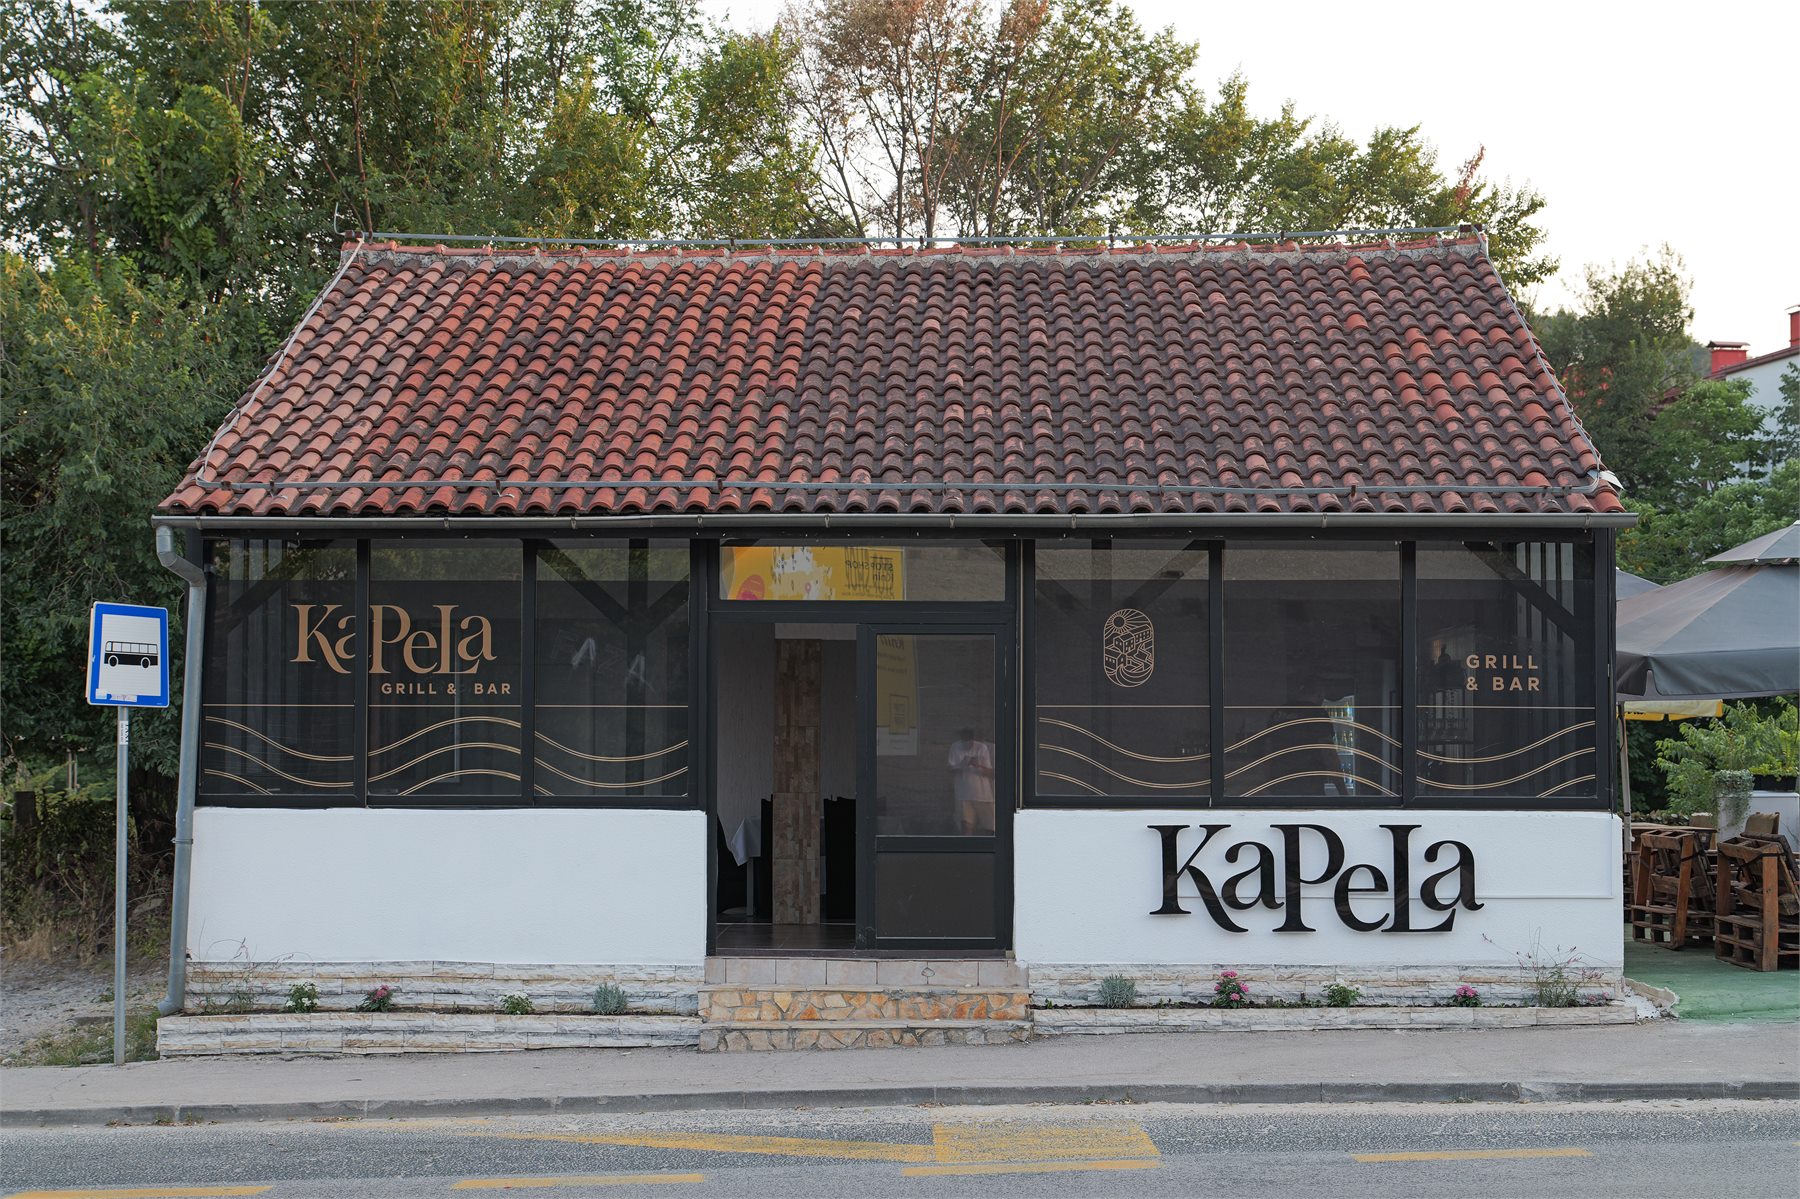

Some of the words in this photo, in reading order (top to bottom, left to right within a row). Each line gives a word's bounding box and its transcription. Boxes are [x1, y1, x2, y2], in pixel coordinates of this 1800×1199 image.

[1466, 654, 1538, 669] GRILL
[381, 682, 437, 695] GRILL
[446, 682, 457, 695] &
[474, 682, 512, 695] BAR
[1466, 676, 1479, 691] &
[1492, 676, 1540, 691] BAR
[1147, 824, 1485, 932] KaPeLa
